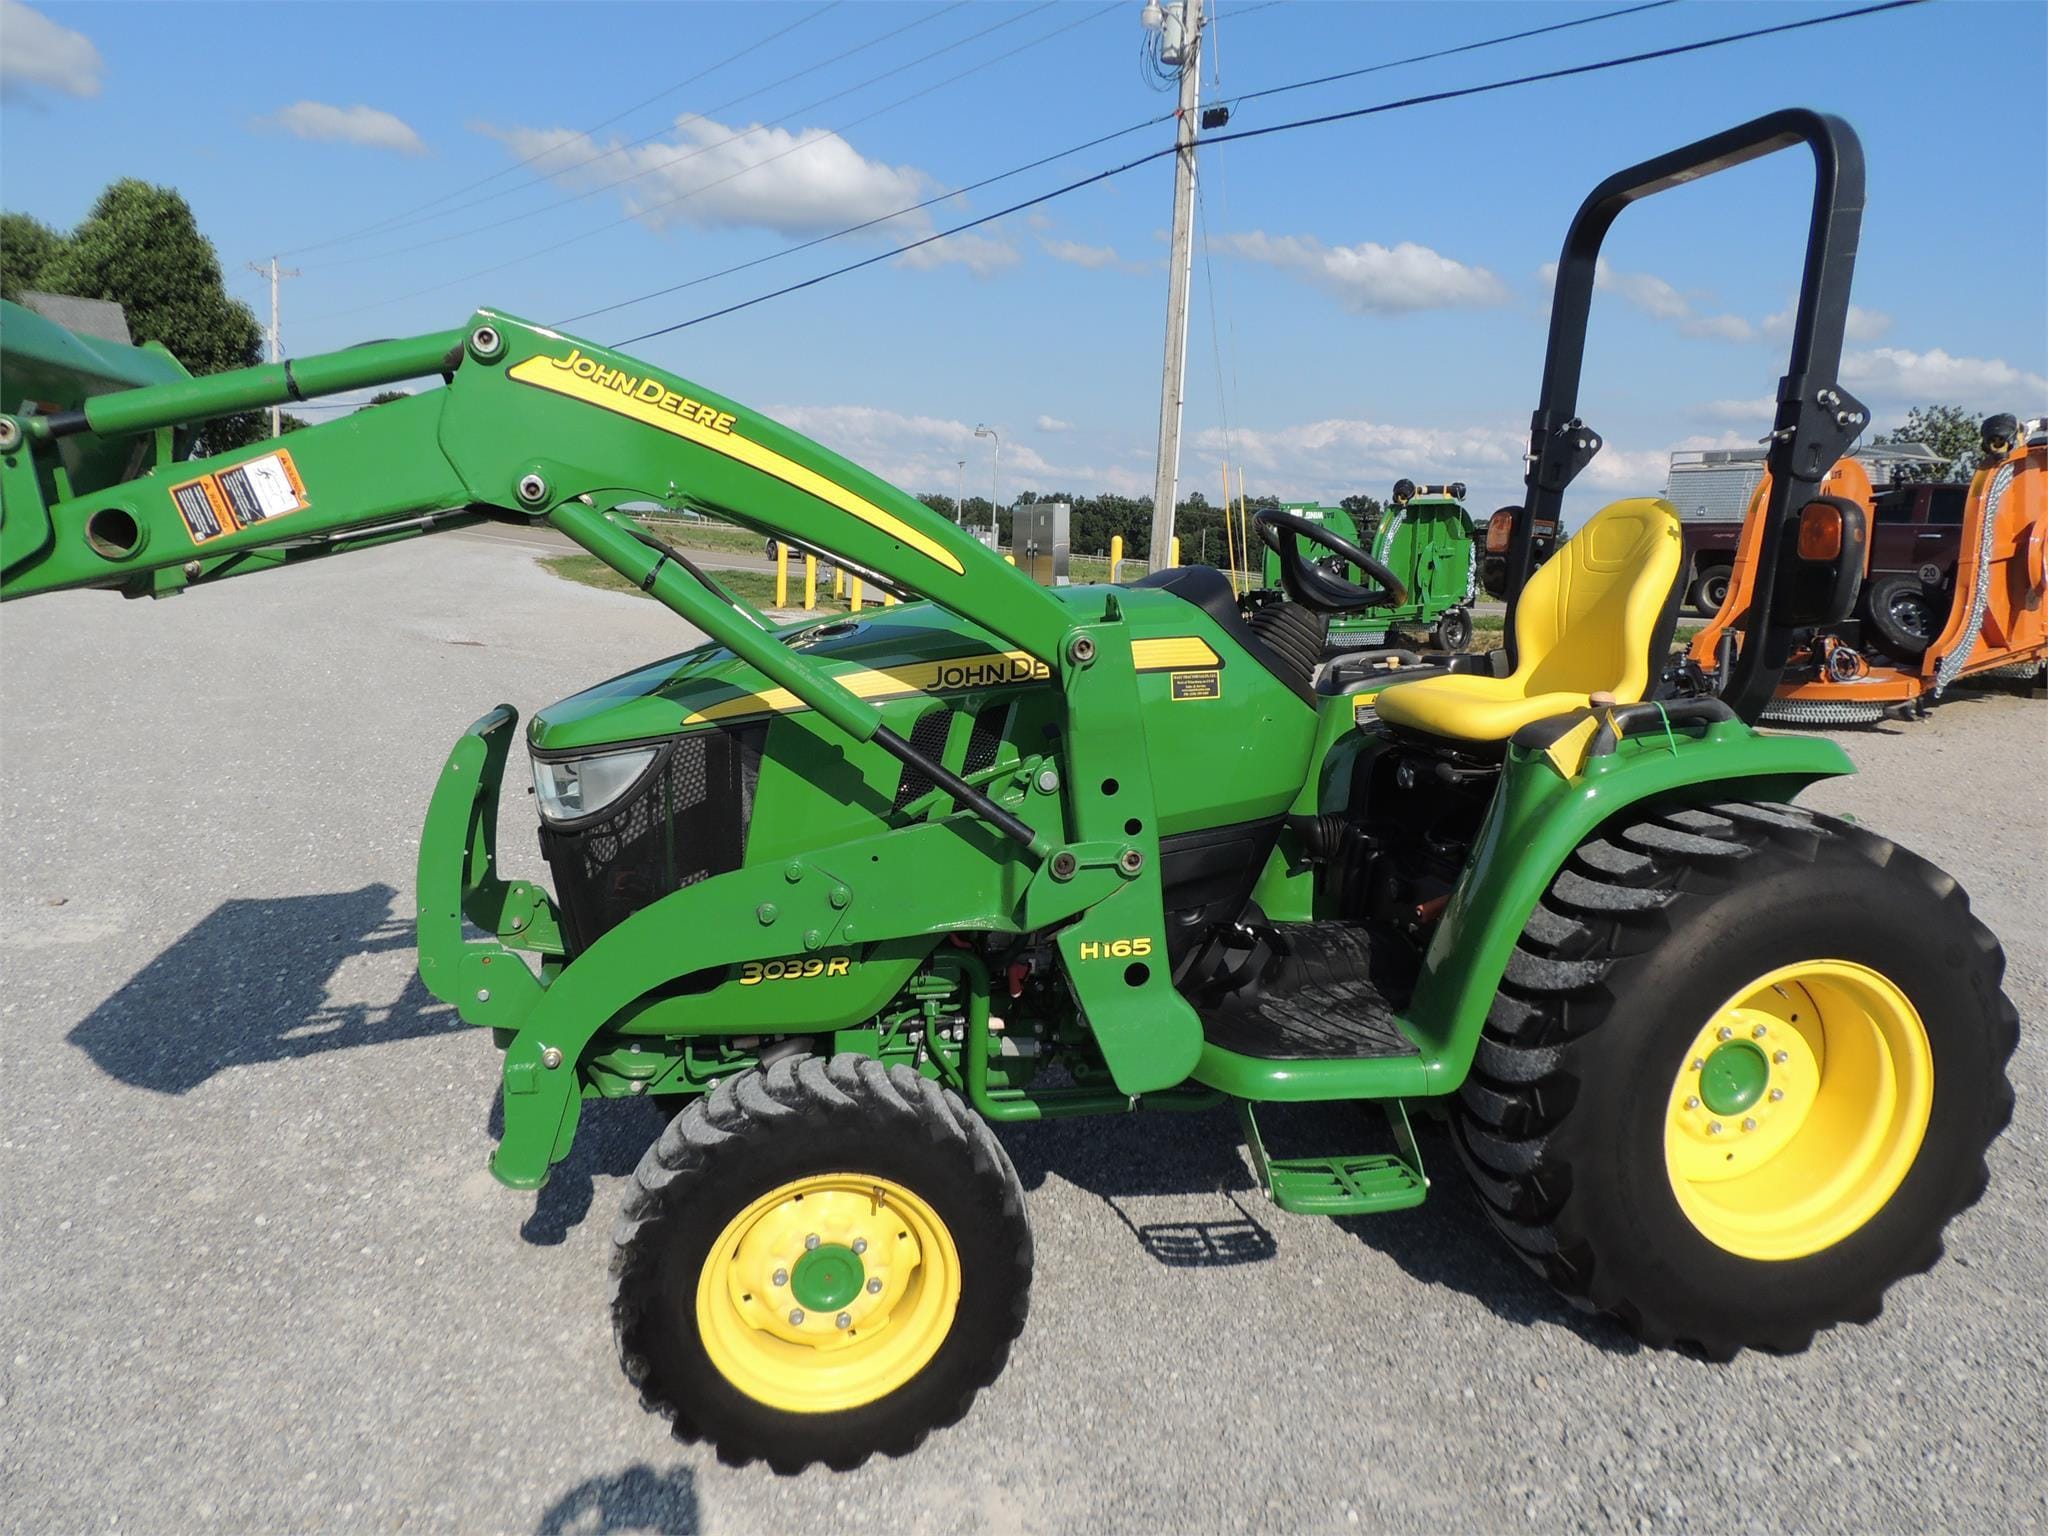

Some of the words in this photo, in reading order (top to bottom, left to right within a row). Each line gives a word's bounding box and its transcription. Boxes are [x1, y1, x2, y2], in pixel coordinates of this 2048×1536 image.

[551, 349, 638, 395] JOHN
[633, 378, 737, 435] DEERE
[1923, 567, 1937, 578] 20
[926, 662, 1005, 689] JOHN
[1010, 657, 1049, 680] DE
